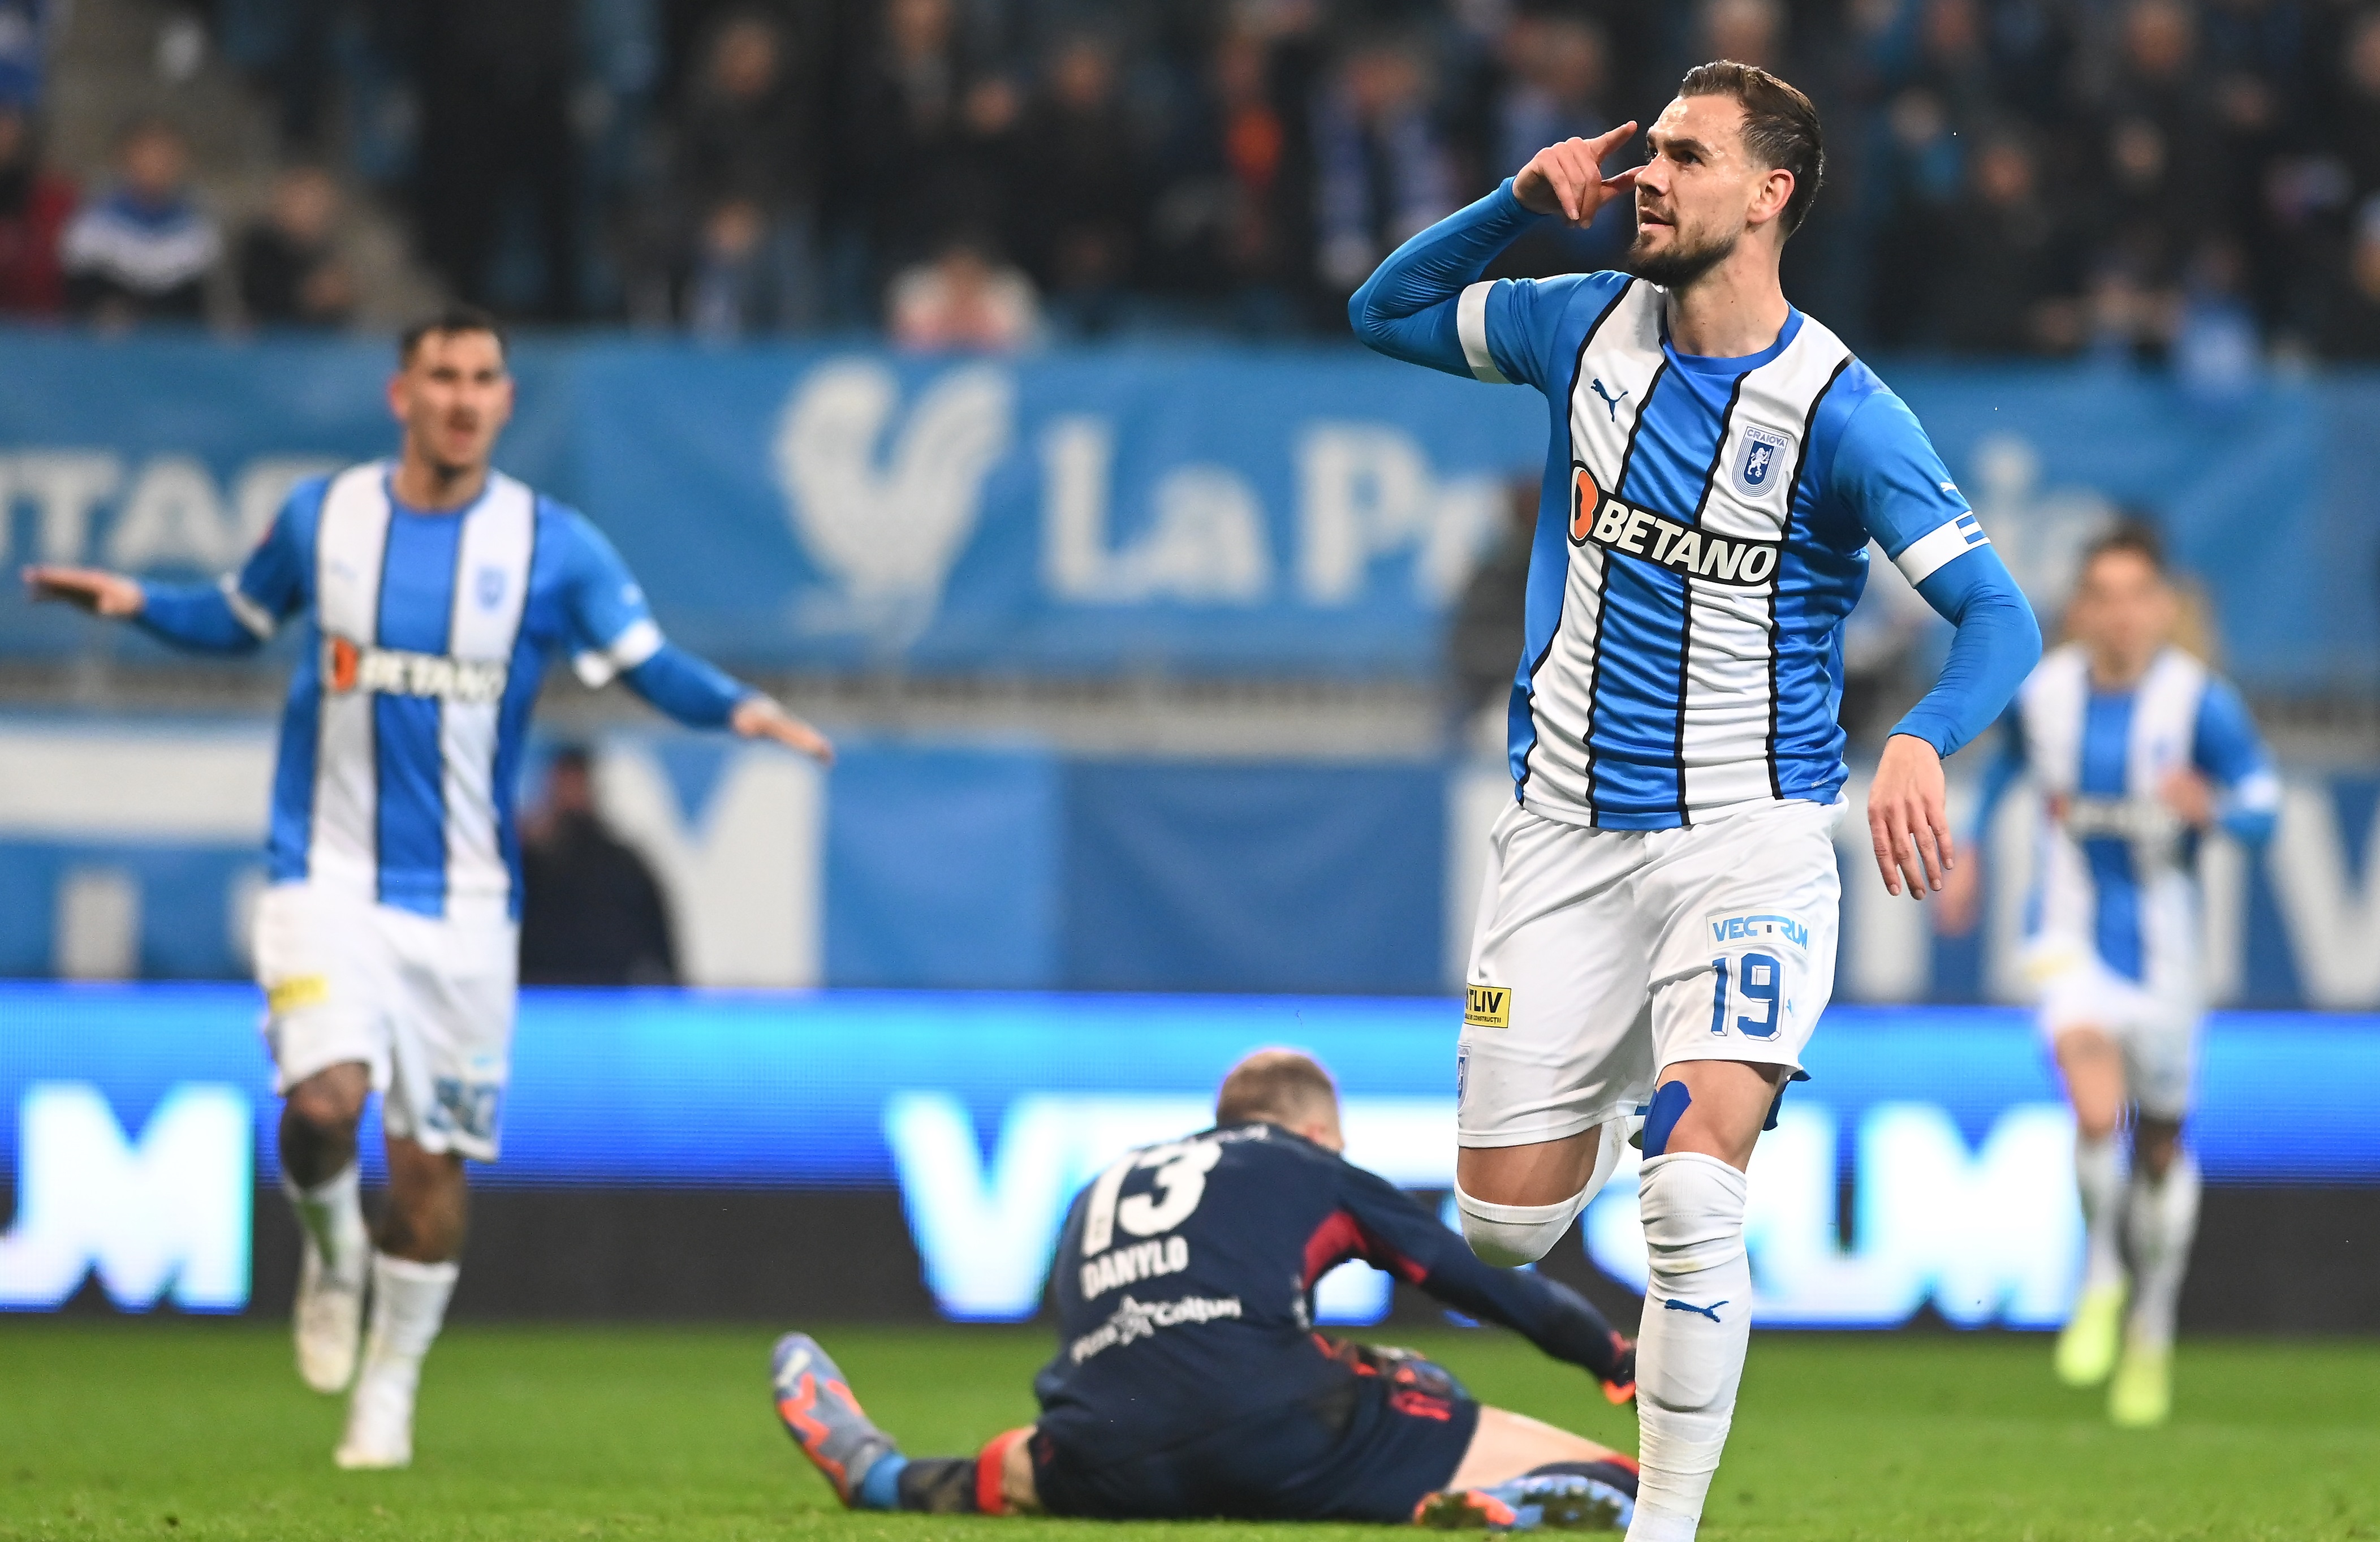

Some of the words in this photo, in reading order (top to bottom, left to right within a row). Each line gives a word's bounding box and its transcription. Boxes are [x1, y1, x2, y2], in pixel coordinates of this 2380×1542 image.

[1747, 429, 1785, 447] CRAIOVA
[1592, 499, 1778, 582] BETANO
[1712, 915, 1808, 950] VECTRUM
[1711, 953, 1785, 1041] 19
[1080, 1140, 1223, 1257] 13
[1079, 1235, 1189, 1300] DANYLO
